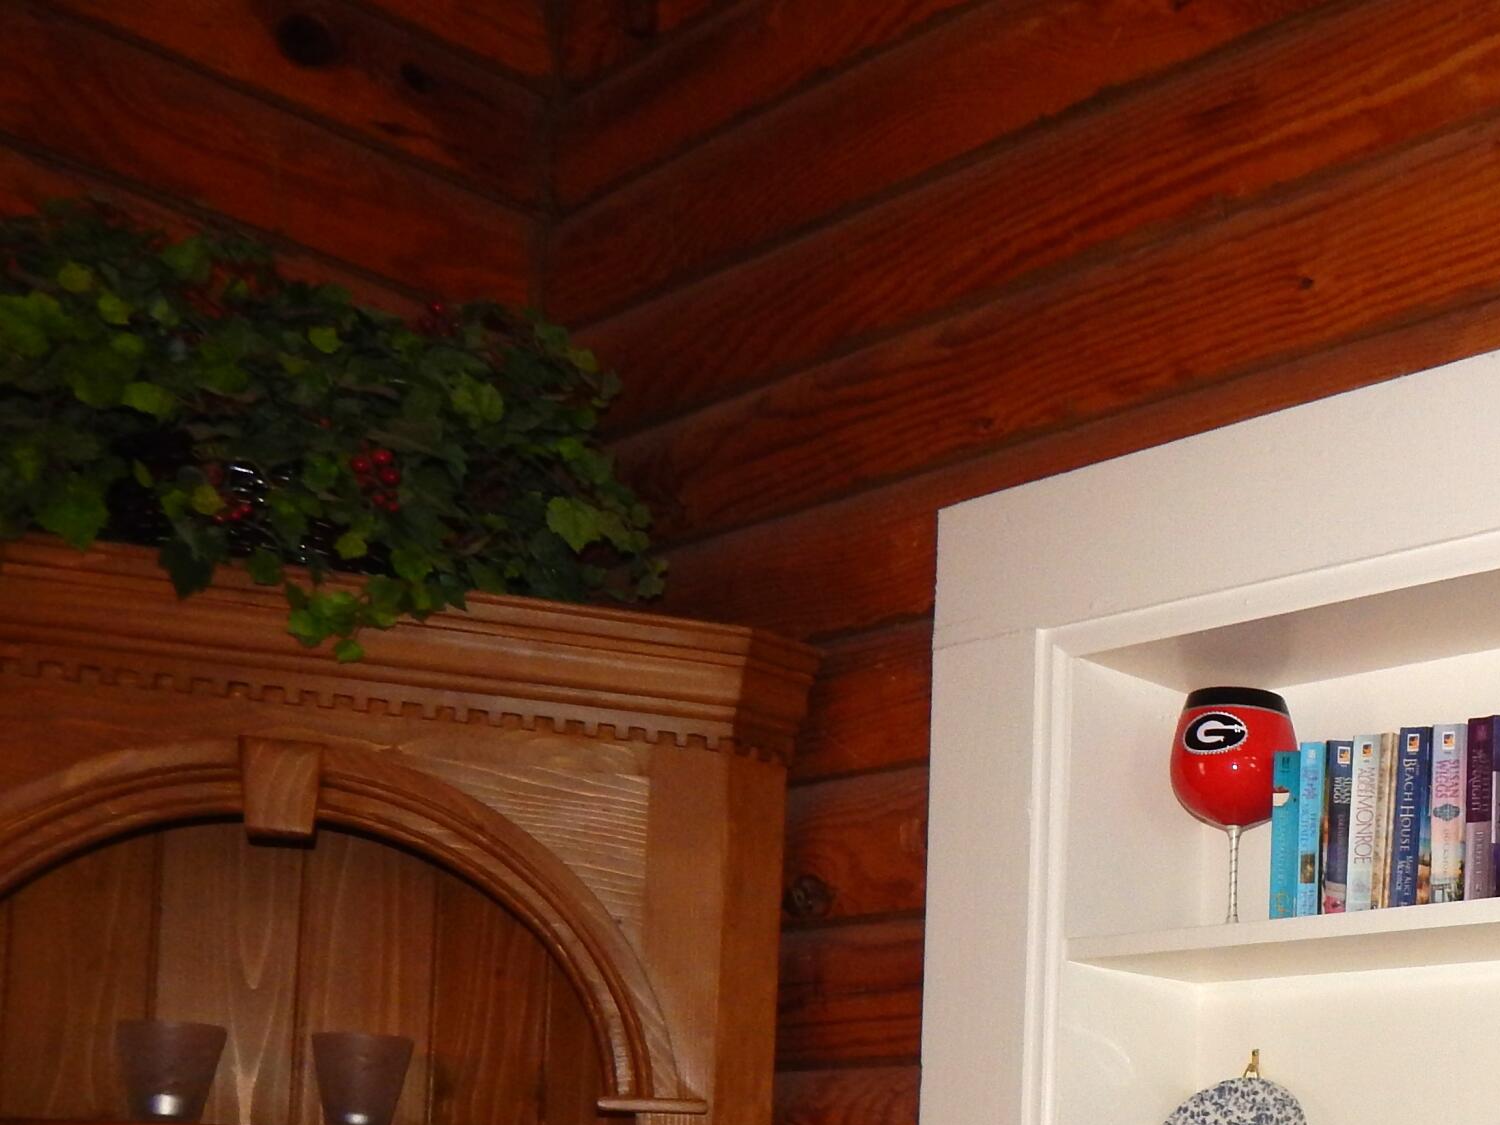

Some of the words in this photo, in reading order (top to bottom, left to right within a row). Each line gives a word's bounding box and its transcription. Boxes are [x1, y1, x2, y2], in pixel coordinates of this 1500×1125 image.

[1333, 776, 1343, 804] WIGGS
[1343, 776, 1352, 804] SUSAN
[1357, 768, 1367, 795] ALICE
[1403, 758, 1418, 801] BEACH
[1435, 759, 1449, 799] WIGGS
[1449, 758, 1460, 798] SUSAN
[1353, 795, 1374, 865] MONROE
[1401, 805, 1416, 851] HOUSE
